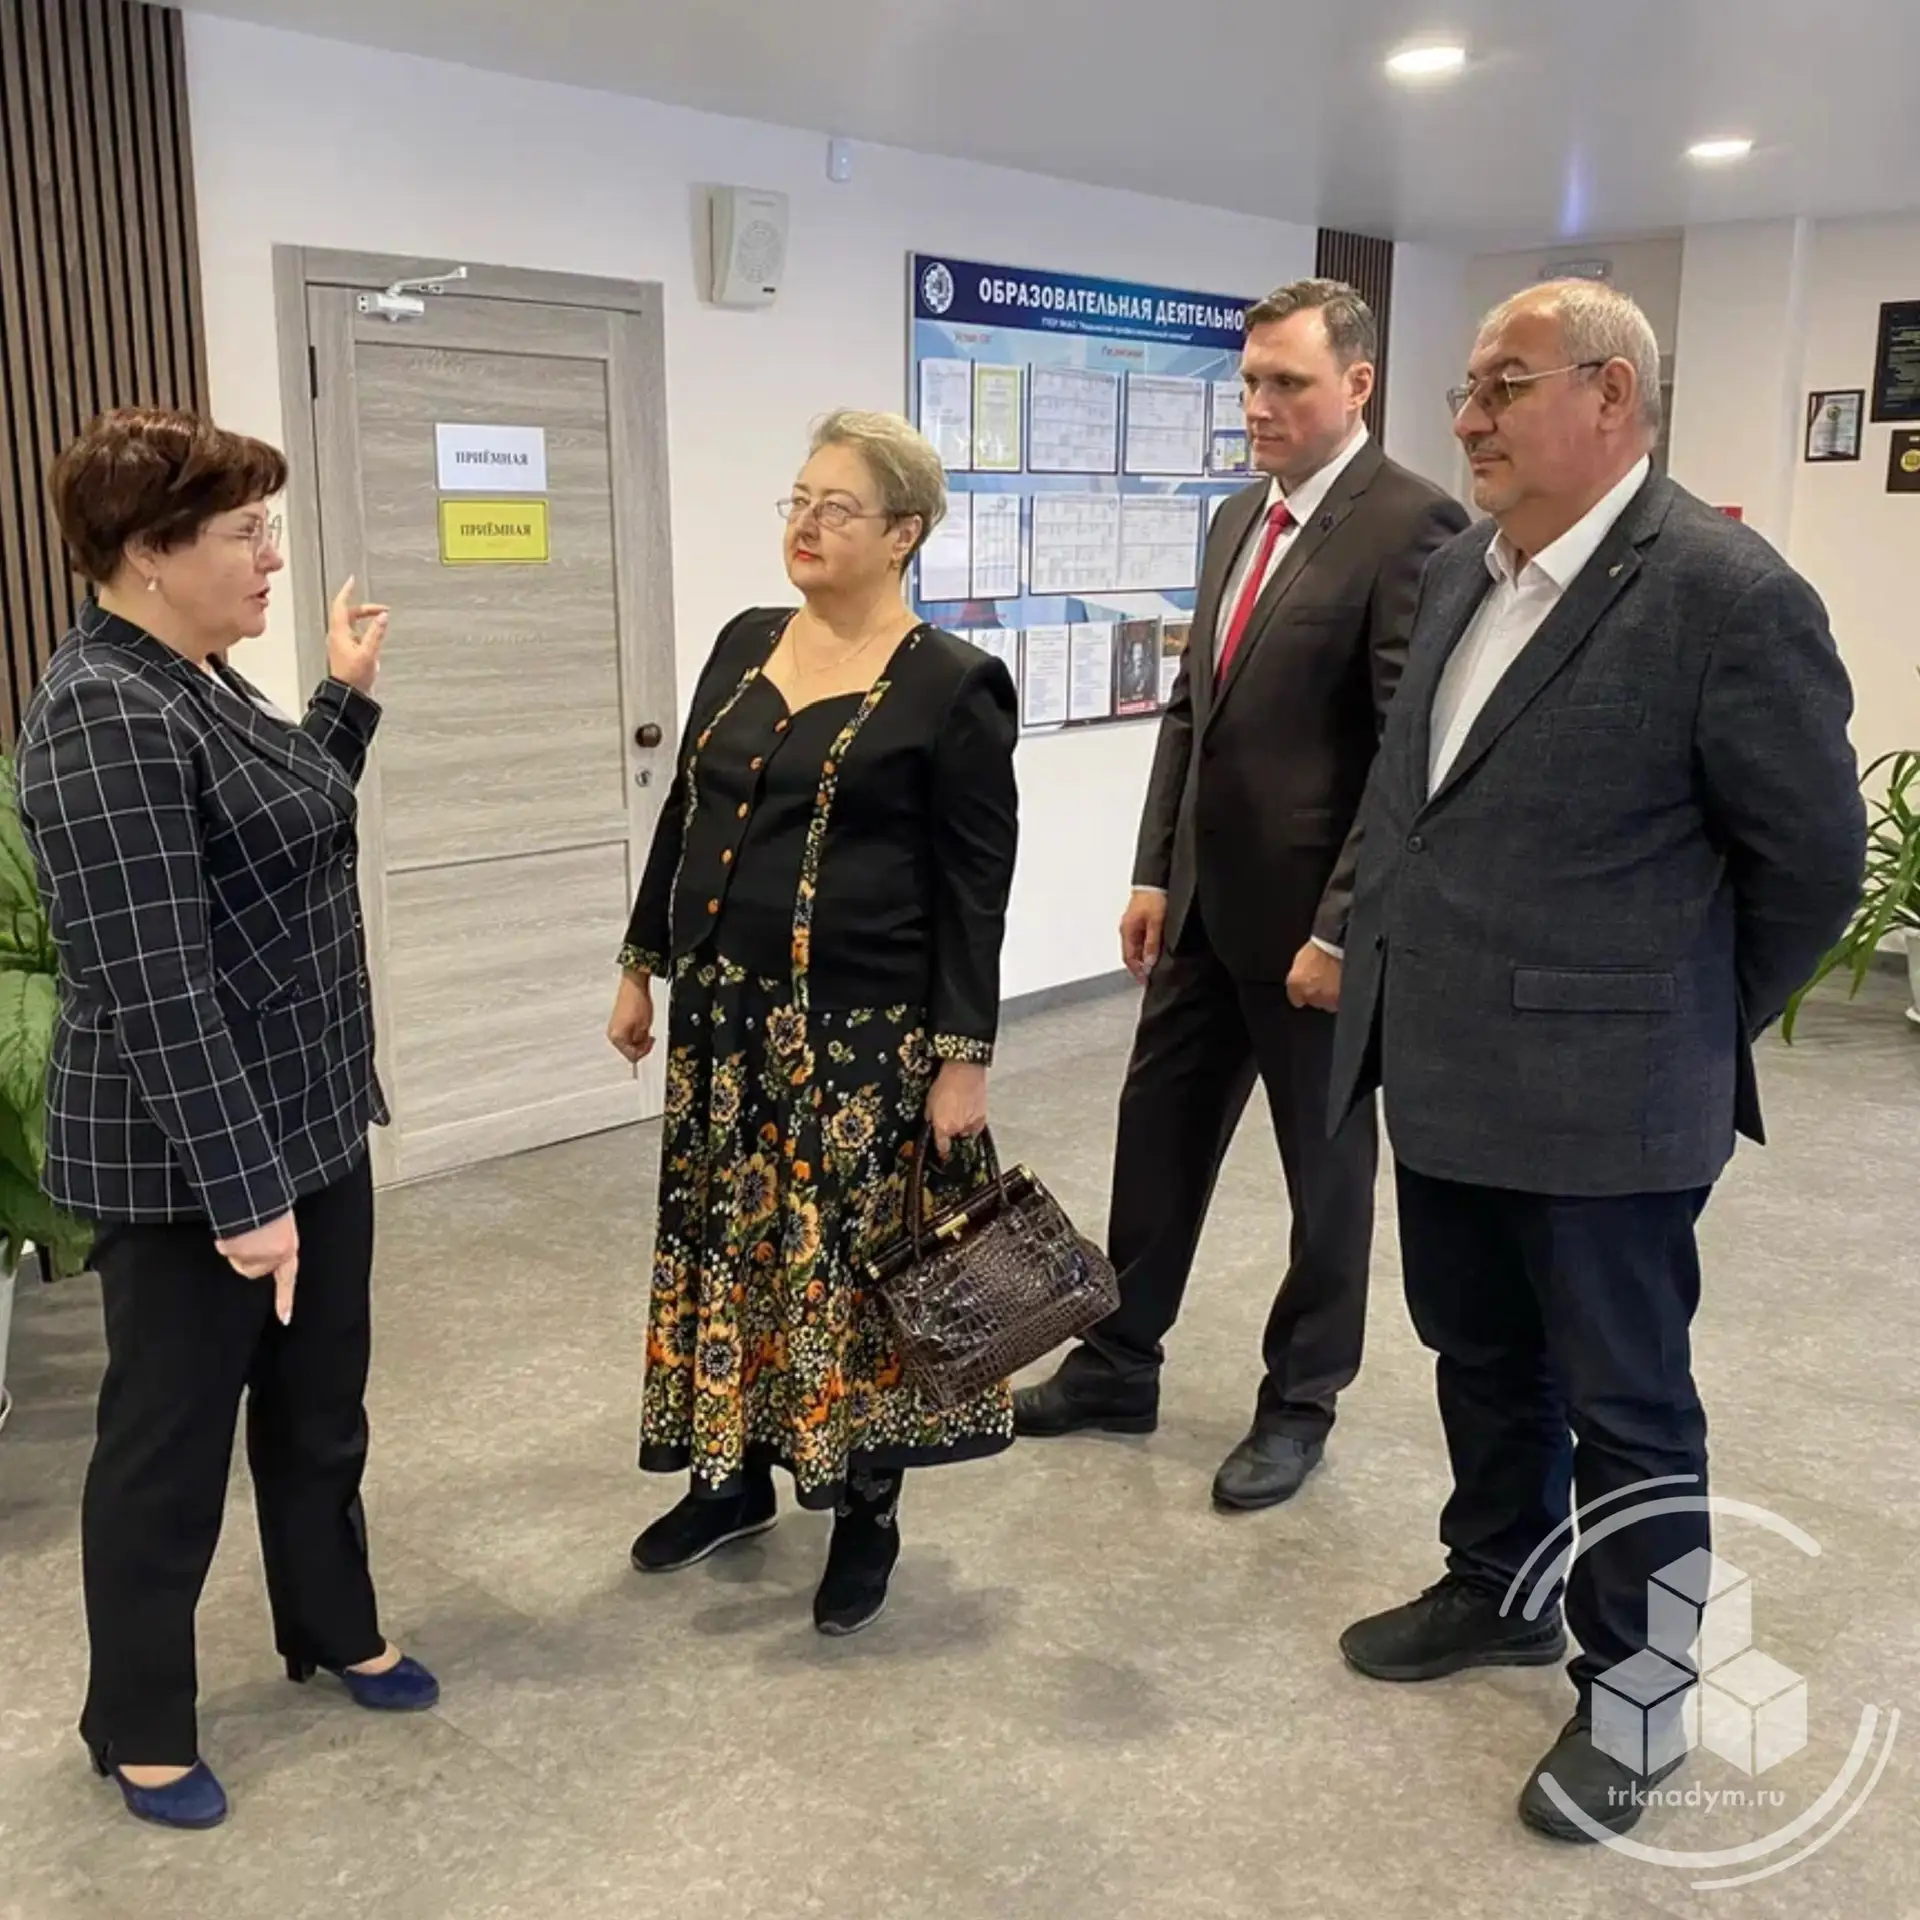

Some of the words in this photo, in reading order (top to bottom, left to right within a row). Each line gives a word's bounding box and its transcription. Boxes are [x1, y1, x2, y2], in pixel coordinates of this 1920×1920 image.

[978, 277, 1153, 321] ОБРАЗОВАТЕЛЬНАЯ
[1154, 300, 1244, 331] ДЕЯТЕЛЬНО
[455, 449, 529, 465] ПРИЁМНАЯ
[460, 521, 531, 537] ПРИЁМНАЯ
